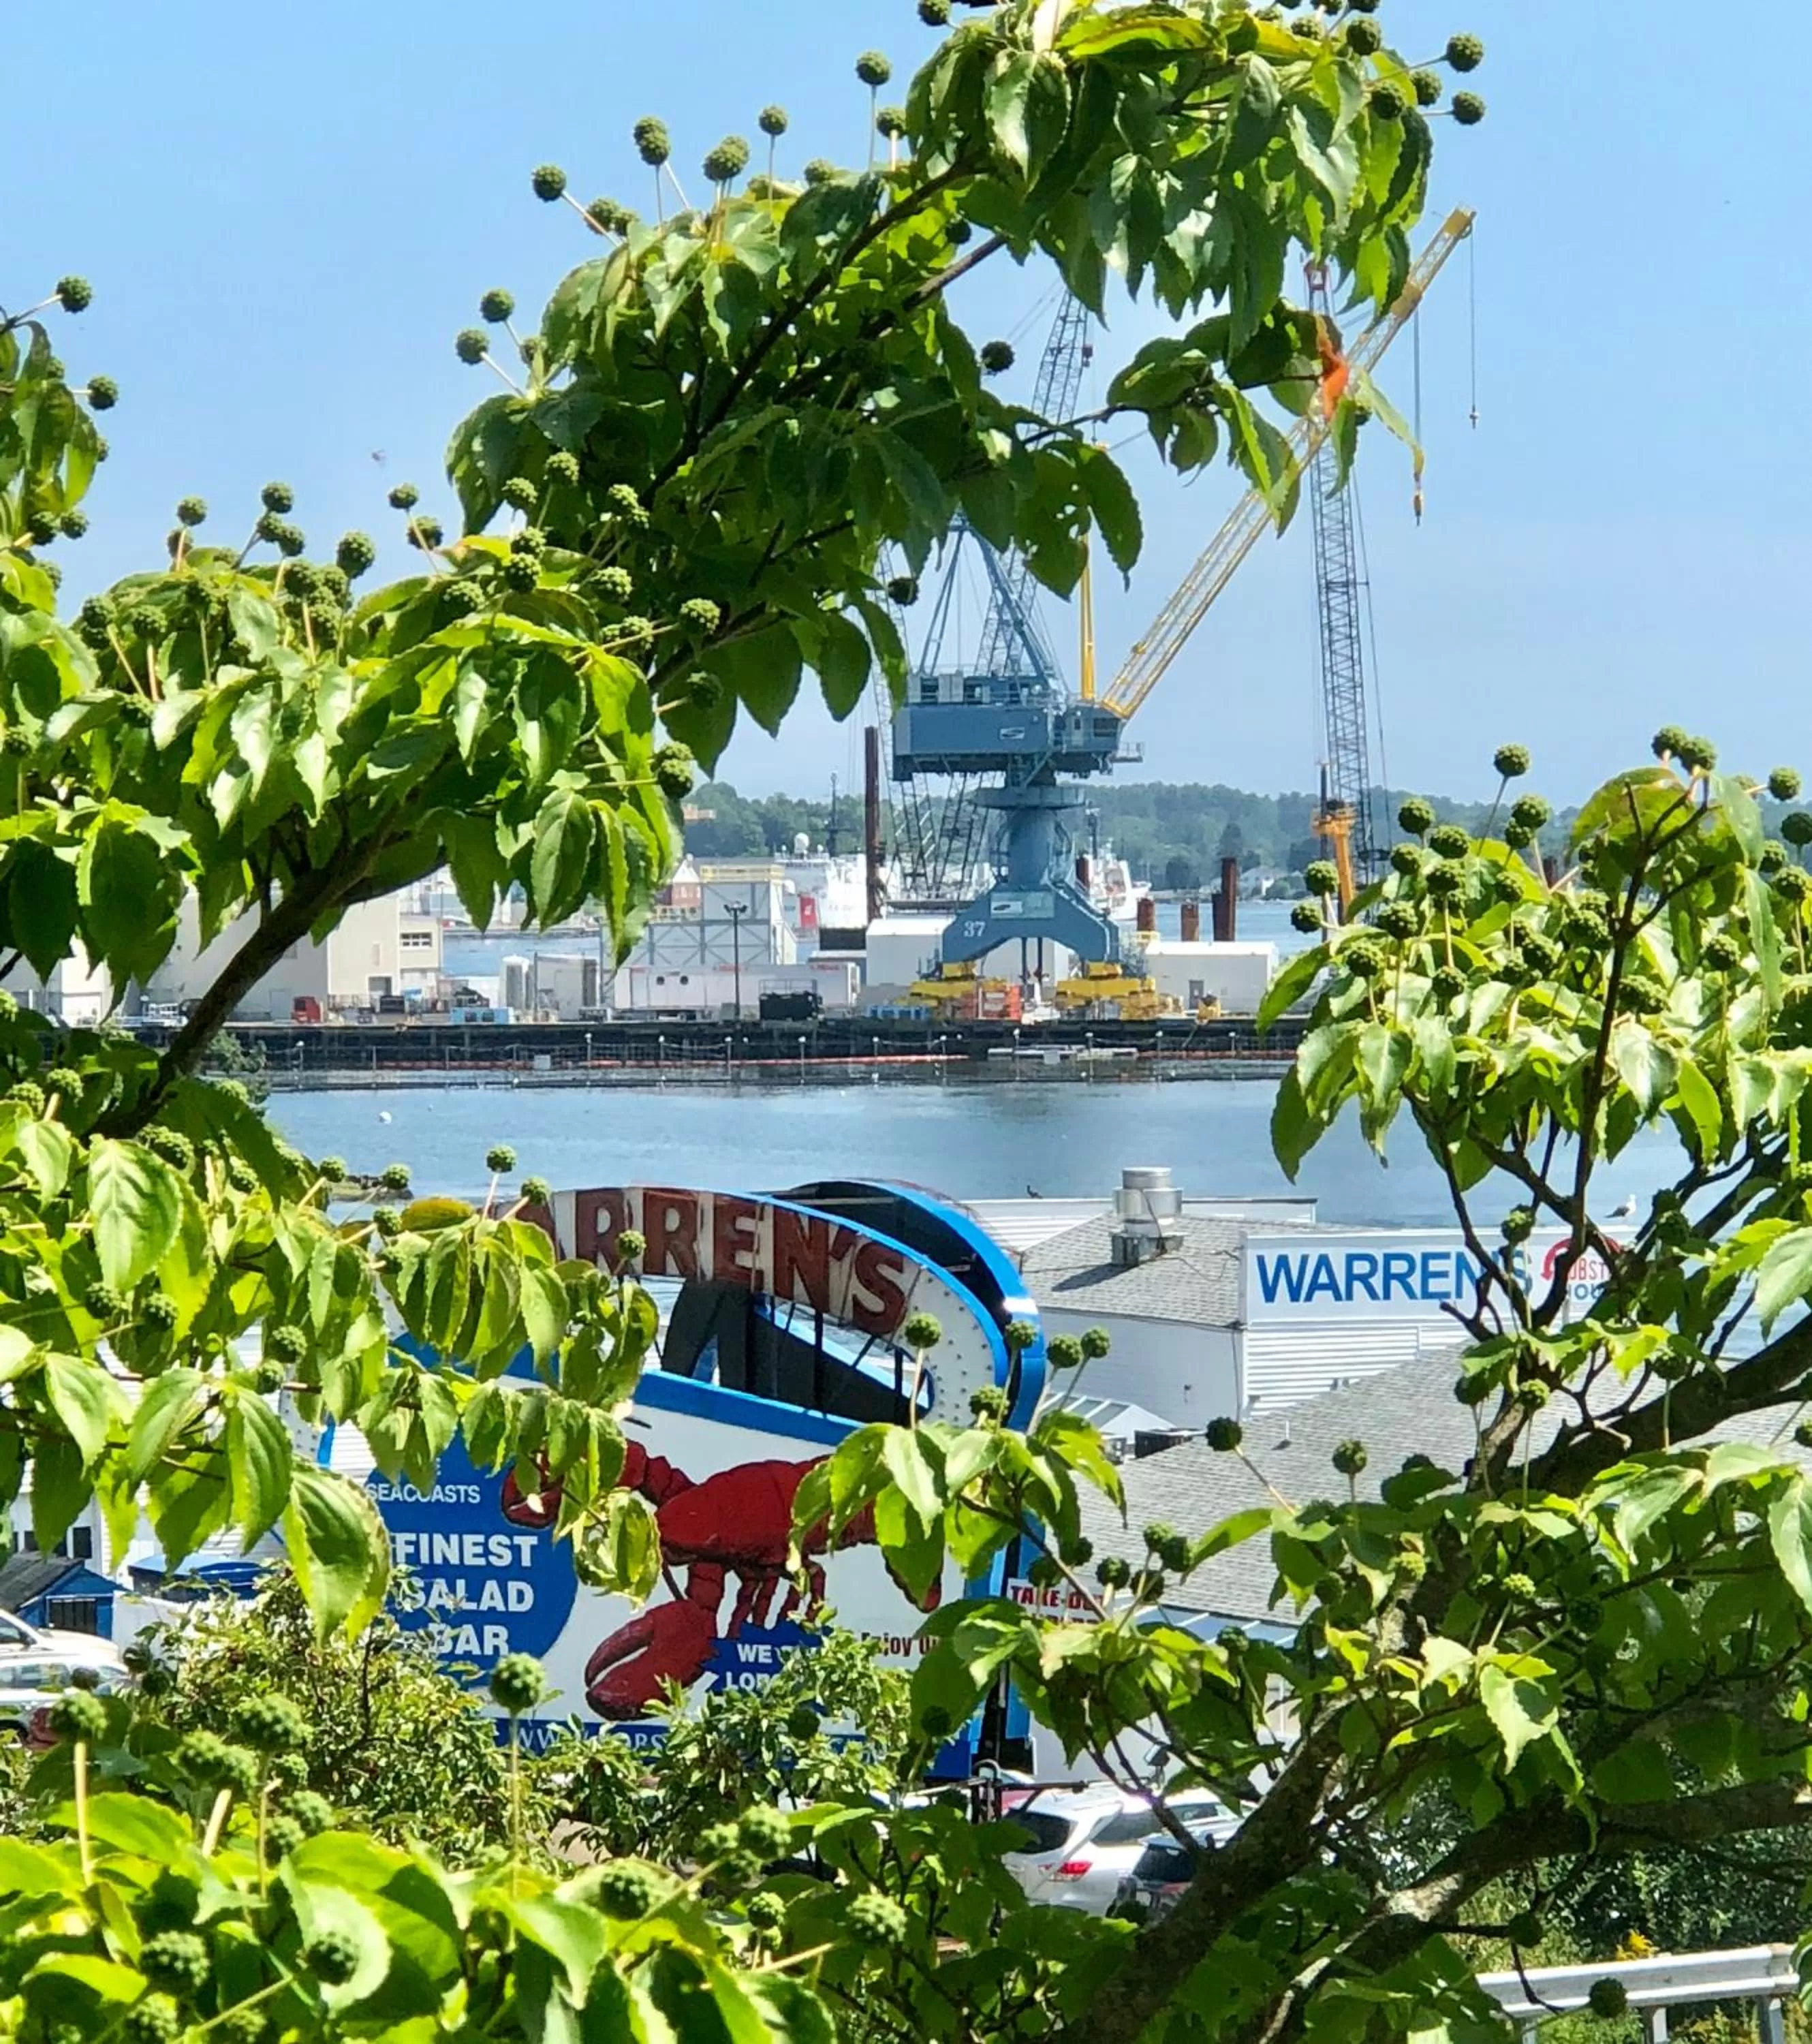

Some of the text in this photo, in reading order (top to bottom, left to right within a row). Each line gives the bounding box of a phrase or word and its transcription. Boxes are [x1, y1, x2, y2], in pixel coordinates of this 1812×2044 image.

[964, 920, 986, 937] 37
[480, 1188, 906, 1336] RREN'S
[394, 1532, 538, 1567] FINEST
[396, 1577, 534, 1613] SALAD
[428, 1623, 509, 1656] BAR
